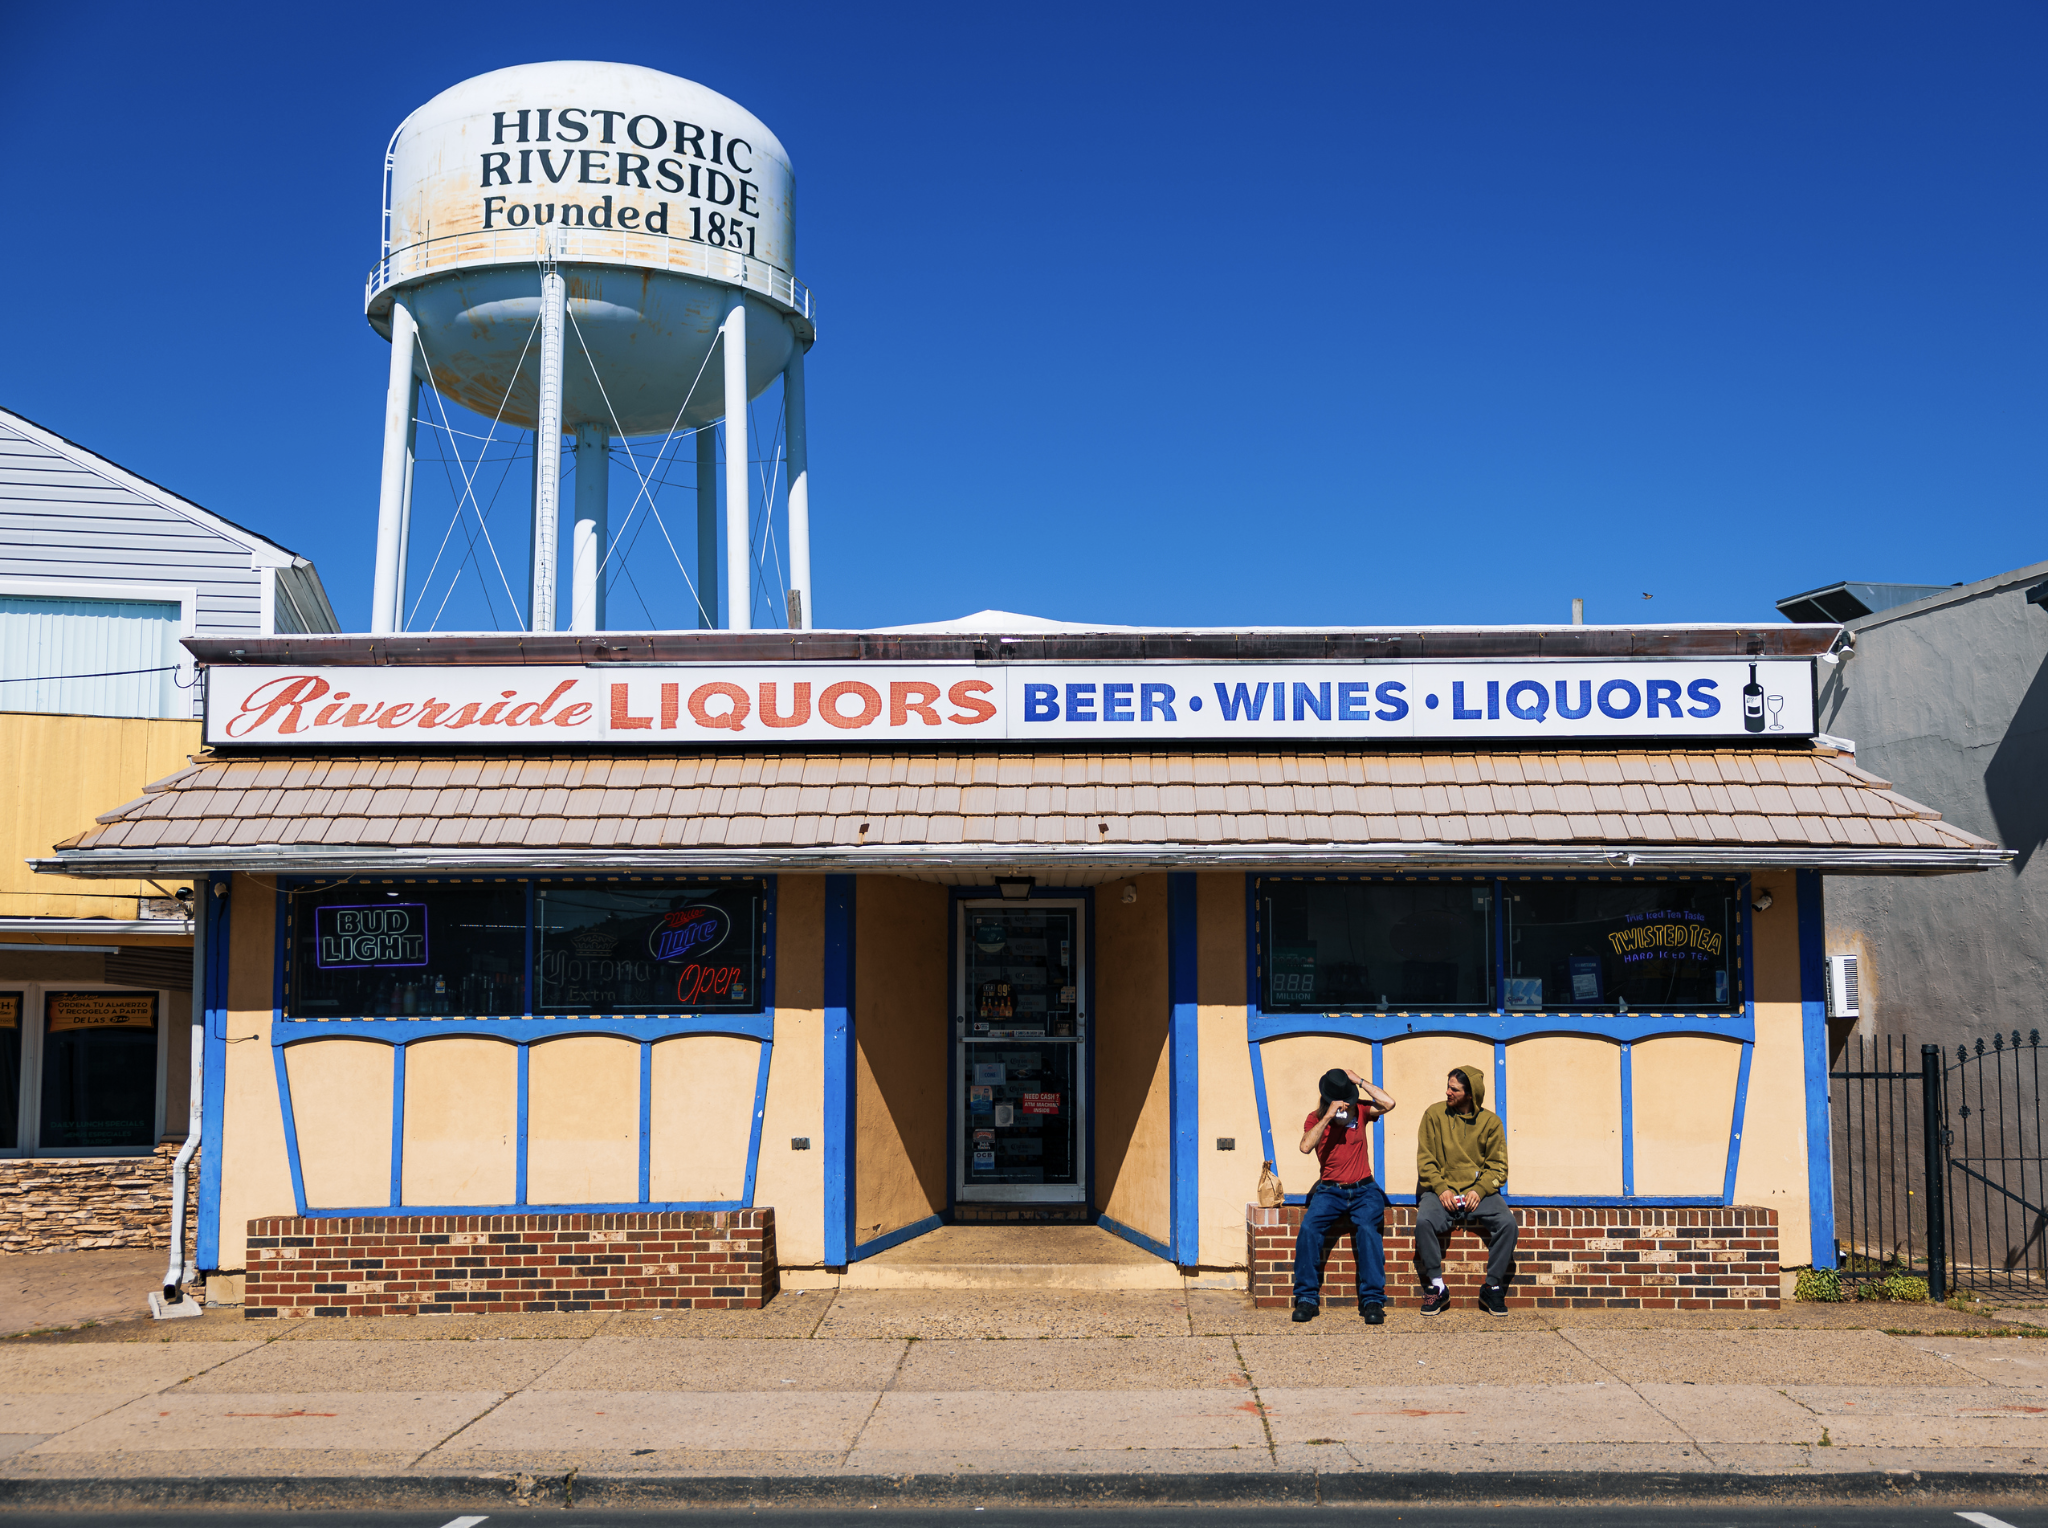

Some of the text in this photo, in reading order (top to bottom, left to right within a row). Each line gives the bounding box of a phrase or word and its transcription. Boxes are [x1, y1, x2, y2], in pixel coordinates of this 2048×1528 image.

[492, 108, 752, 174] HISTORIC
[480, 149, 760, 219] RIVERSIDE
[483, 195, 756, 257] Founded 1851
[225, 675, 1721, 738] Riverside LIQUORS BEER WINES LIQUORS
[337, 909, 409, 935] BUD
[664, 907, 707, 928] Miller
[1625, 909, 1705, 923] True Iced Tea Taste
[323, 935, 424, 961] LIGHT
[656, 919, 718, 961] Lite
[1608, 924, 1723, 955] TWISTED TEA
[1624, 952, 1654, 963] HARD
[678, 964, 747, 1005] Open
